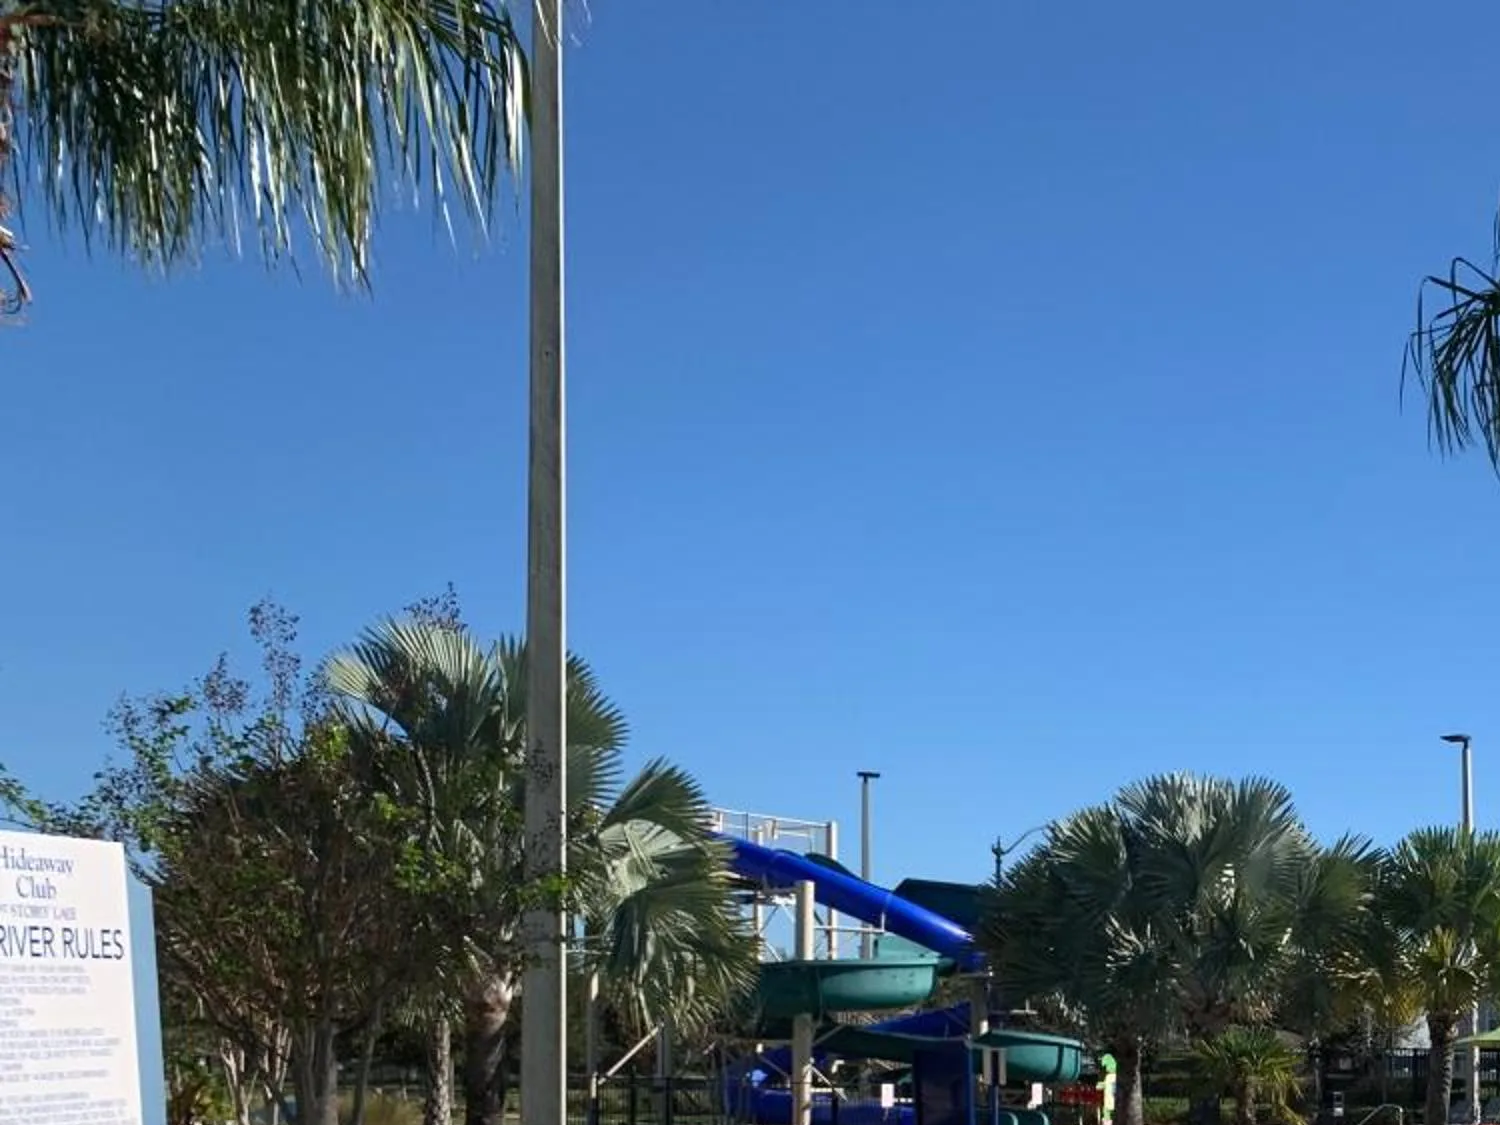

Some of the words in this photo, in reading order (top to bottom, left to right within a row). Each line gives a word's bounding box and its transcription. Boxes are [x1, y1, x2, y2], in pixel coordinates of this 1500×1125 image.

[15, 875, 58, 899] Club
[0, 924, 56, 958] RIVER
[61, 927, 125, 960] RULES
